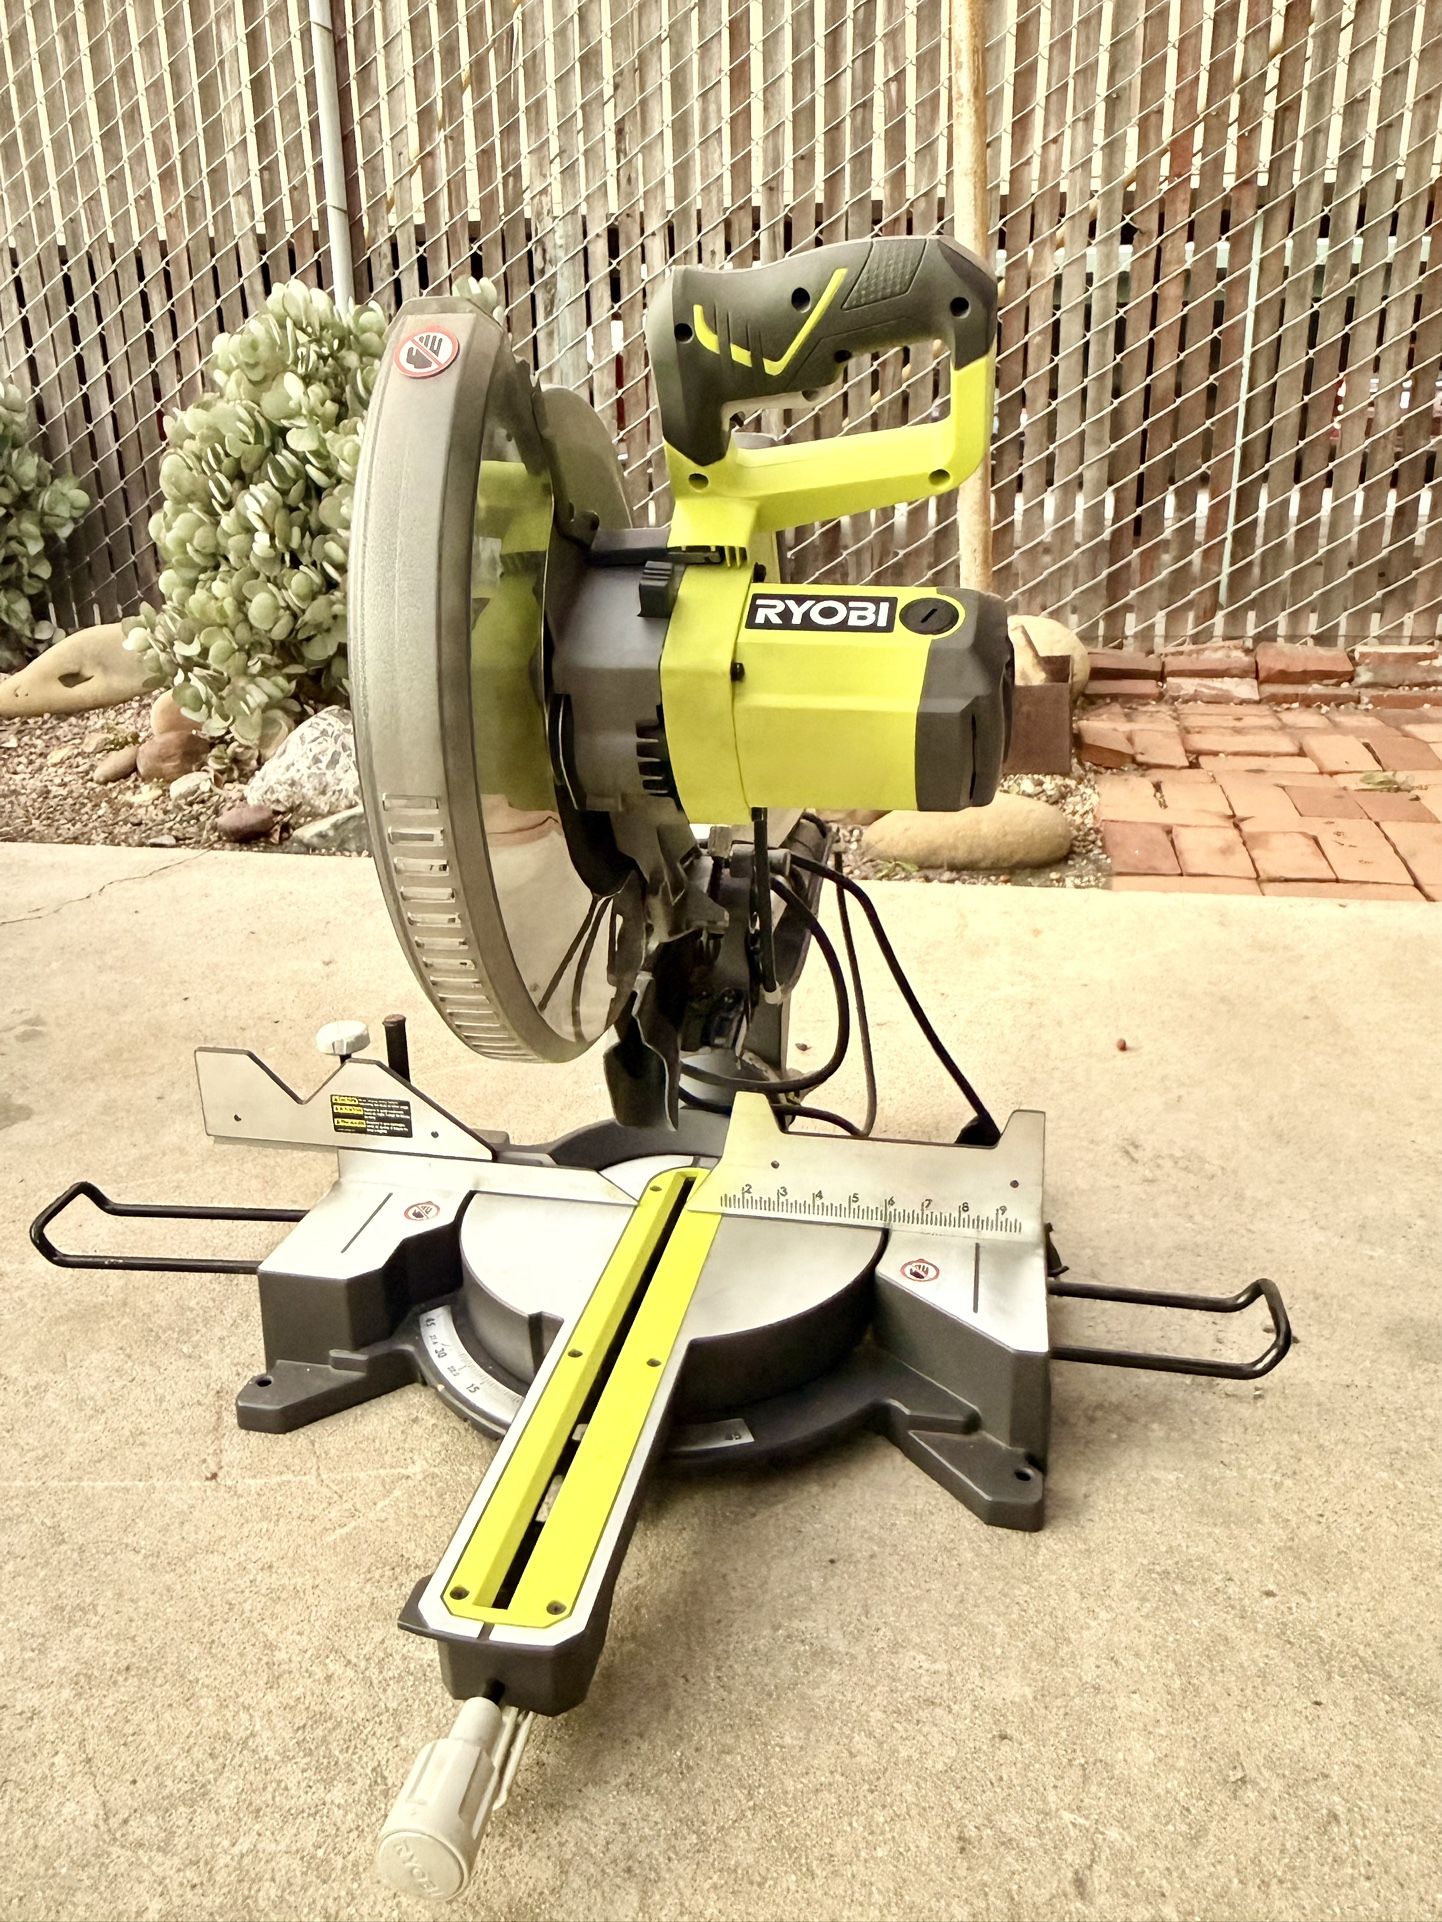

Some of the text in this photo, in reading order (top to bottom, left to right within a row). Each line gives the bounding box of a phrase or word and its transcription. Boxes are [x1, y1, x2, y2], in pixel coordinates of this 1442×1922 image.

[755, 599, 889, 627] RYOBI
[745, 1184, 1007, 1215] 2 3 4 5 6 7 8 9
[435, 1347, 447, 1358] 30
[466, 1383, 480, 1393] 15
